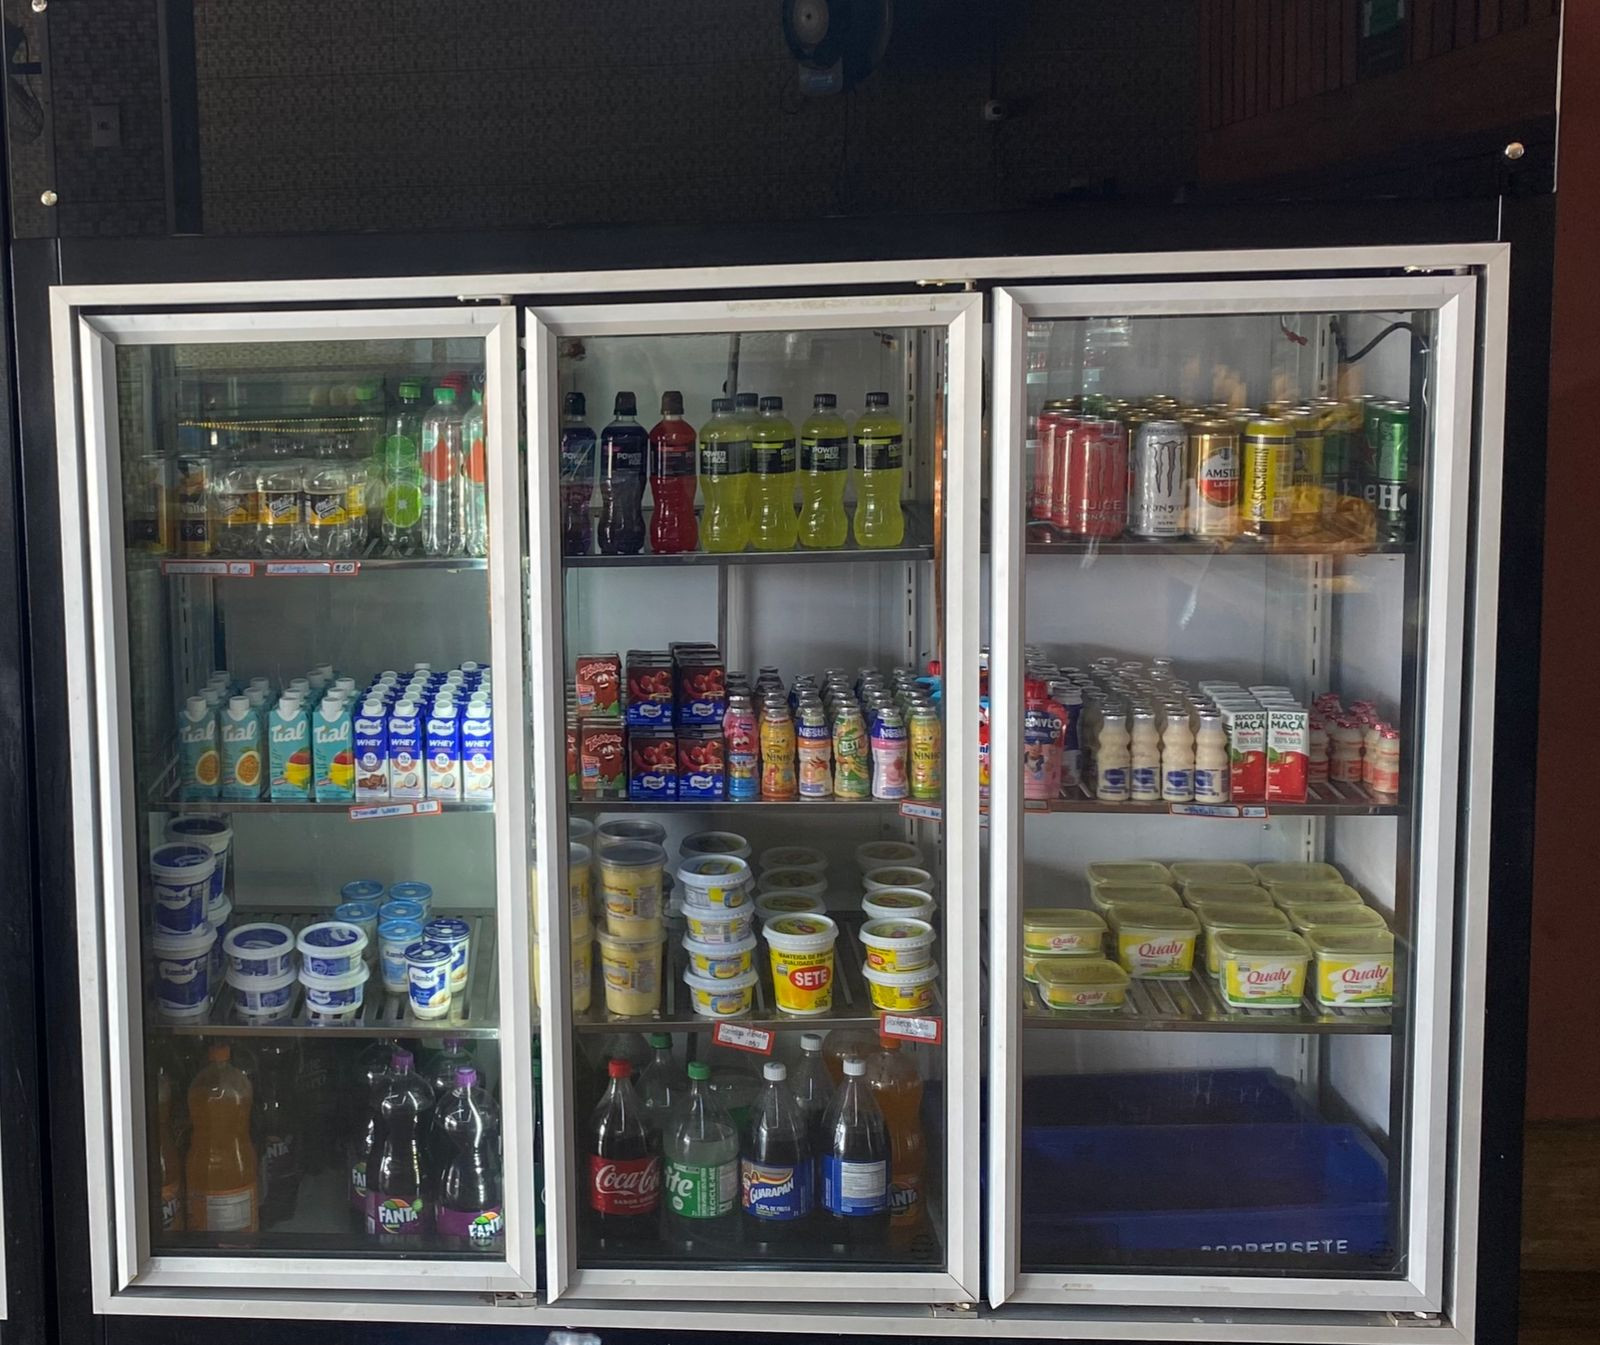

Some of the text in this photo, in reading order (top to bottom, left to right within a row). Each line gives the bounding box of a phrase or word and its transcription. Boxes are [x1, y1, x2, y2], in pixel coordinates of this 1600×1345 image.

[1271, 713, 1305, 722] SUCO DE
[272, 720, 307, 743] Tial
[314, 720, 350, 744] Tial
[1234, 720, 1265, 732] MAÇÃ
[1270, 721, 1305, 731] MAÇÃ
[357, 738, 383, 747] WHEY
[391, 738, 417, 747] WHEY
[429, 739, 456, 748] WHEY
[465, 740, 492, 748] WHEY
[1137, 940, 1182, 958] Qualy
[795, 970, 827, 986] SETE
[1247, 966, 1291, 985] Qualy
[1342, 964, 1389, 984] Qualy
[750, 1178, 794, 1204] GUARAPAN
[378, 1205, 419, 1224] FANTA
[1201, 1239, 1349, 1254] PERSETE
